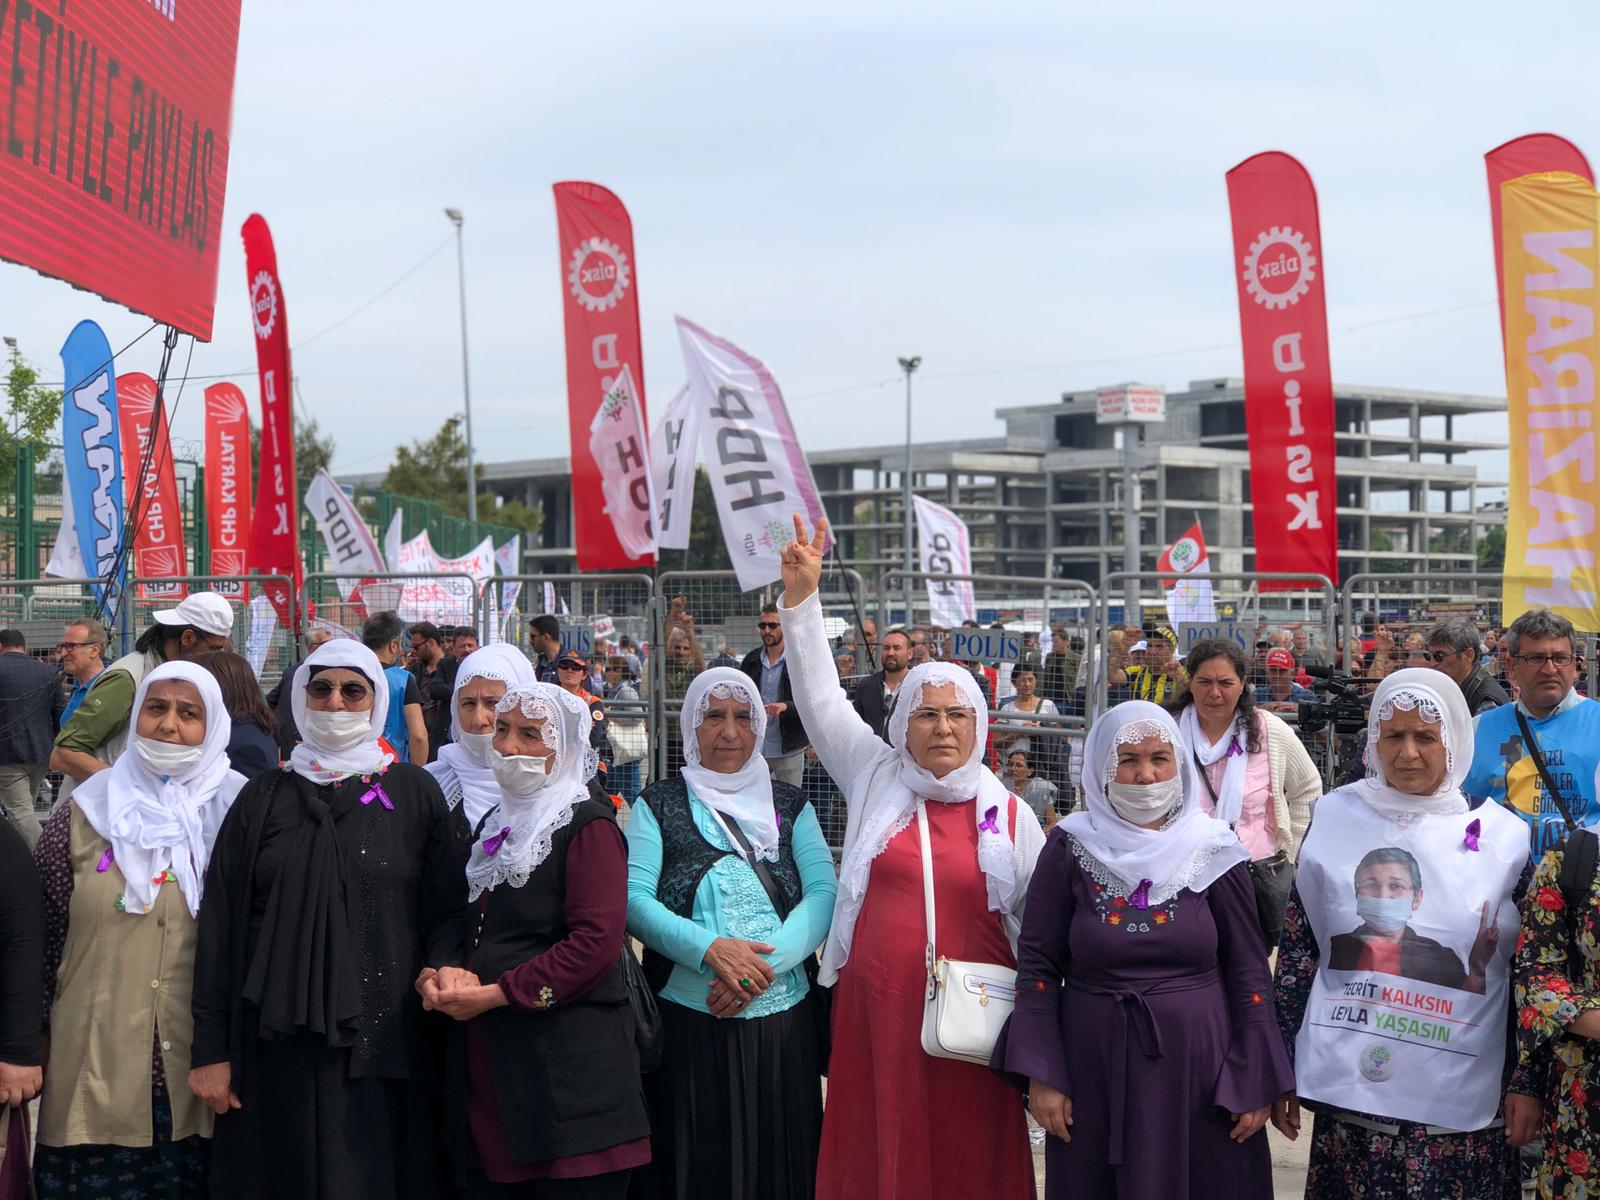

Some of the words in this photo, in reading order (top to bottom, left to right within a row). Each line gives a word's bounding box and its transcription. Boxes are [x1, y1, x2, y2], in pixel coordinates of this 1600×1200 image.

[954, 631, 1019, 661] POLİS
[1343, 978, 1378, 998] TECRİT
[1382, 986, 1453, 1015] KALKSIN
[1331, 1005, 1368, 1025] LEYLA
[1375, 1011, 1451, 1043] YAŞASIN
